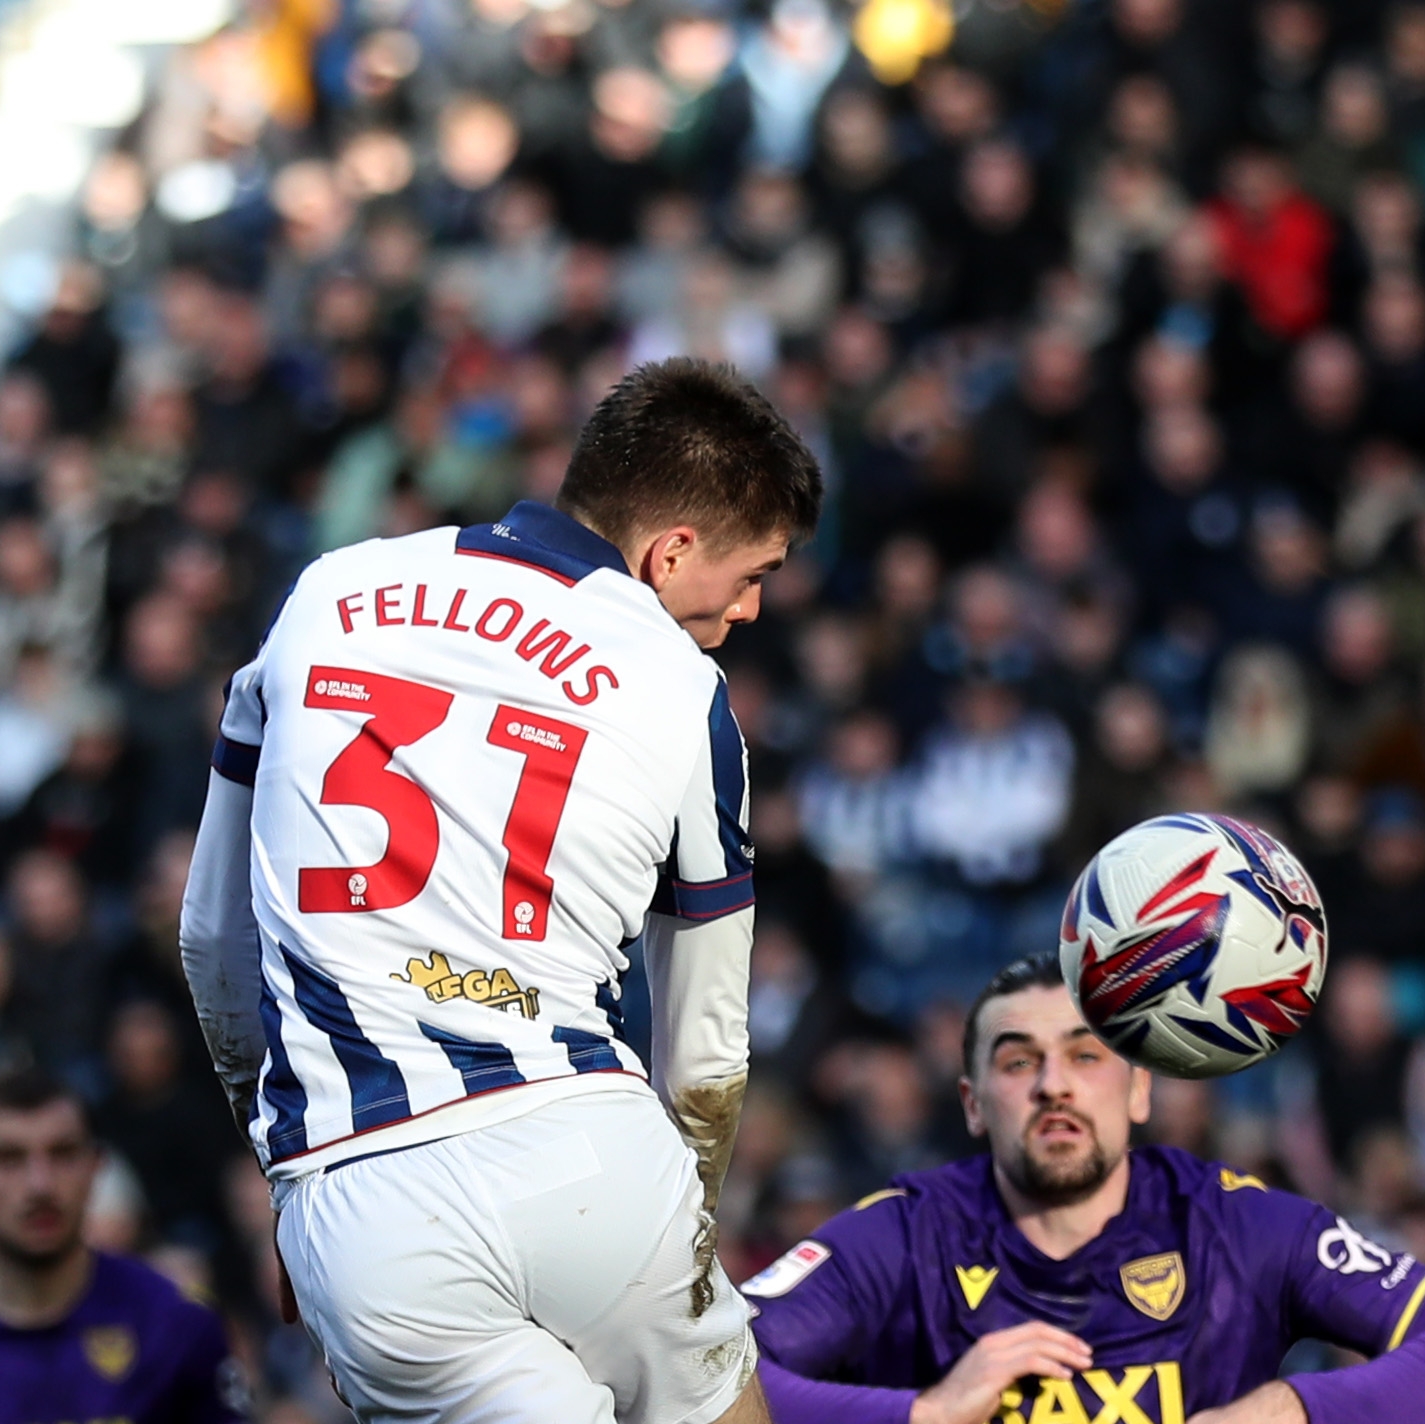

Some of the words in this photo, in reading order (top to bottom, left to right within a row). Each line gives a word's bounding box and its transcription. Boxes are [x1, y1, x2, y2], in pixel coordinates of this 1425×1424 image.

[337, 583, 619, 706] FELLOWS
[350, 895, 366, 906] EFL
[516, 922, 532, 934] EFL
